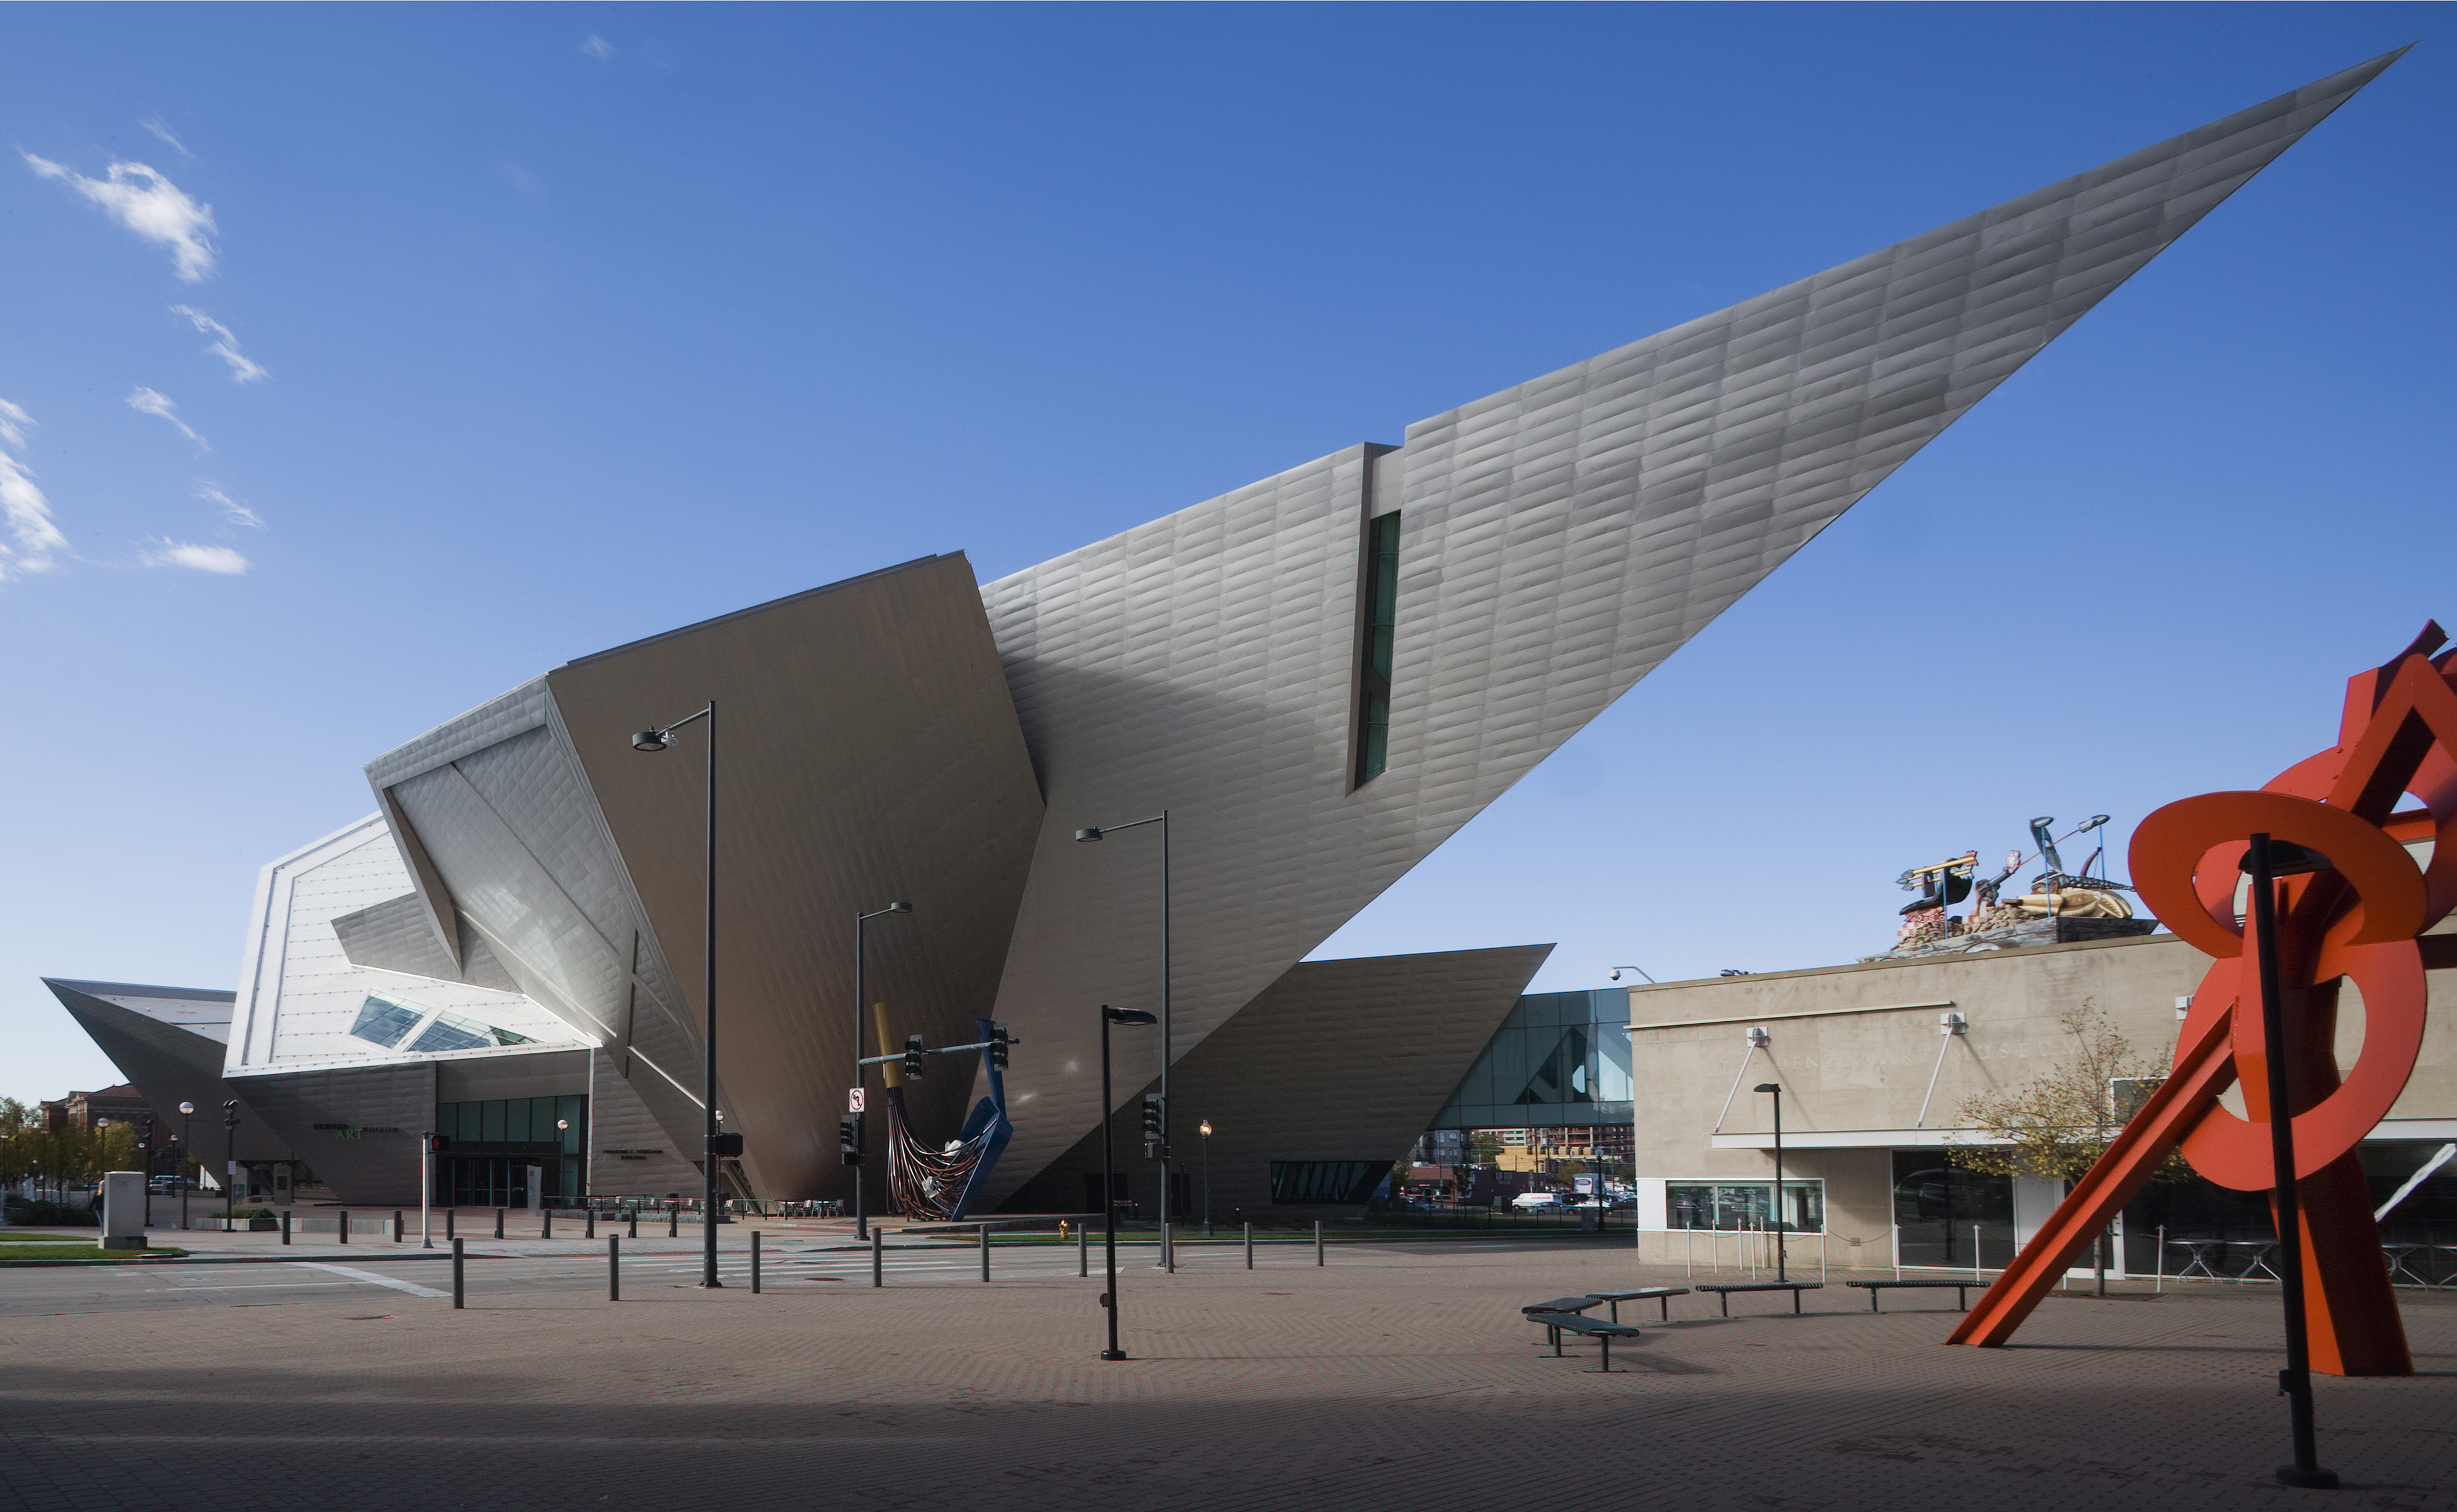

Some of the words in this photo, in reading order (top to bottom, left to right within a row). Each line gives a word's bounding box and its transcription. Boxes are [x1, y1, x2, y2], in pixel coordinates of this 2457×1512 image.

[1775, 1053, 1868, 1070] DENVER
[1879, 1048, 1932, 1065] ART
[336, 1128, 363, 1140] ART
